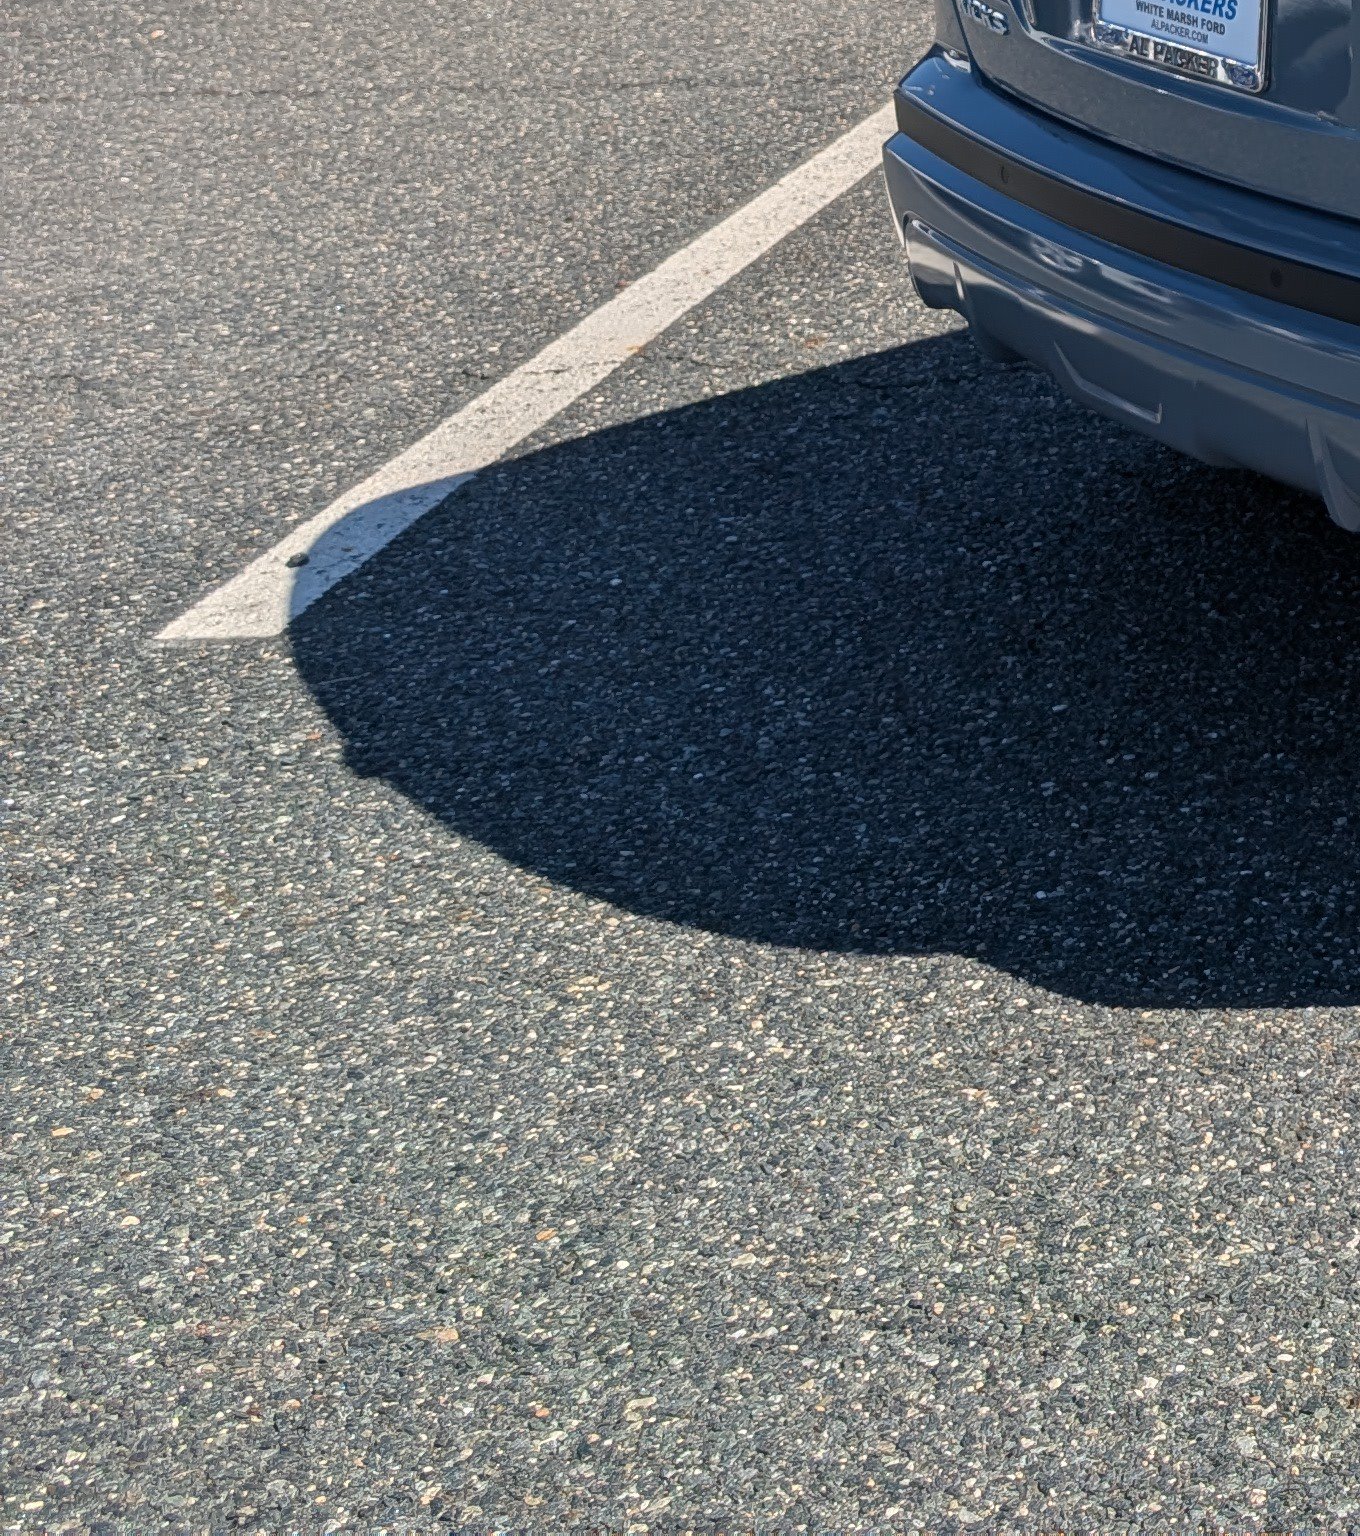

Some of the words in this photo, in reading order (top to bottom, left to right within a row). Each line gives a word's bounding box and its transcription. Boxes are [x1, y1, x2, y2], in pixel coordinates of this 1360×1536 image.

[1135, 0, 1165, 19] WHITE
[1166, 7, 1199, 28] MARSH
[1200, 18, 1226, 35] FORD
[1150, 18, 1209, 44] ALPACKER.COM
[1128, 34, 1149, 57] AL
[1153, 40, 1220, 80] PACKER
